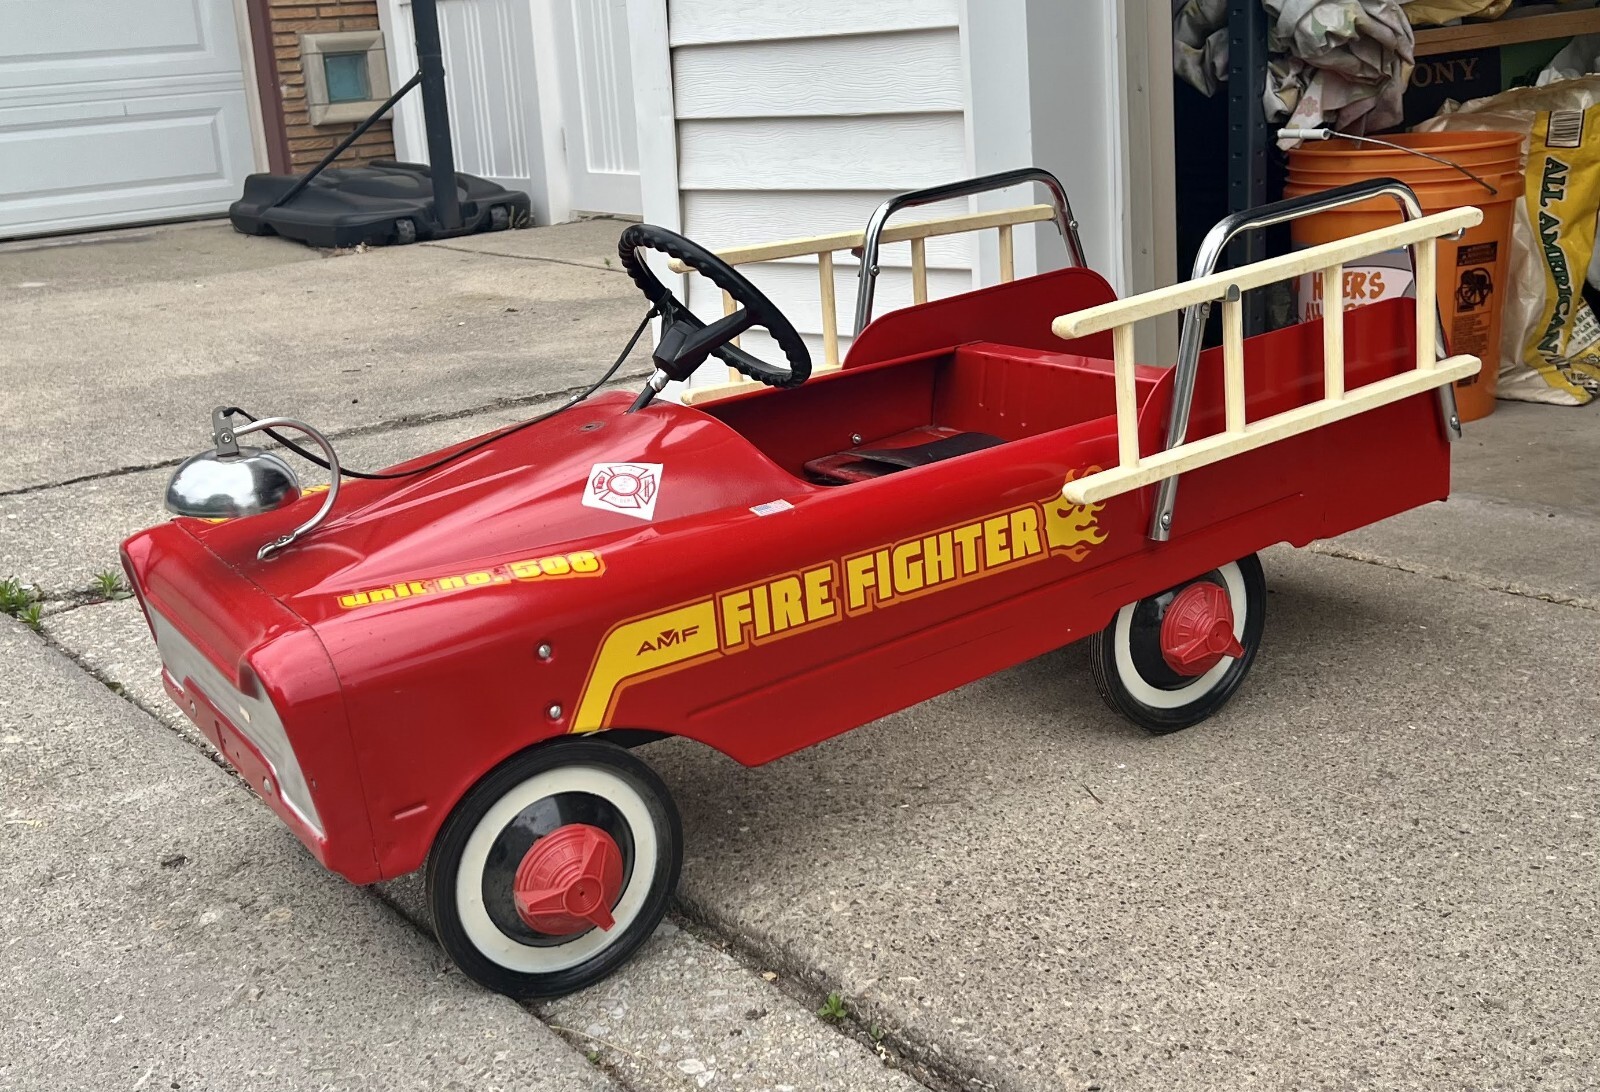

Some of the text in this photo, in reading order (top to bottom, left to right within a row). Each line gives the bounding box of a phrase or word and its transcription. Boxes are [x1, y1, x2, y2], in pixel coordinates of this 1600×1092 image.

[1411, 58, 1479, 88] ONY
[1537, 156, 1573, 354] ALL AMERICAN
[1312, 271, 1386, 301] HER'S
[510, 550, 601, 579] 508
[721, 507, 1041, 647] FIRE FIGHTER
[635, 625, 702, 657] AMF
